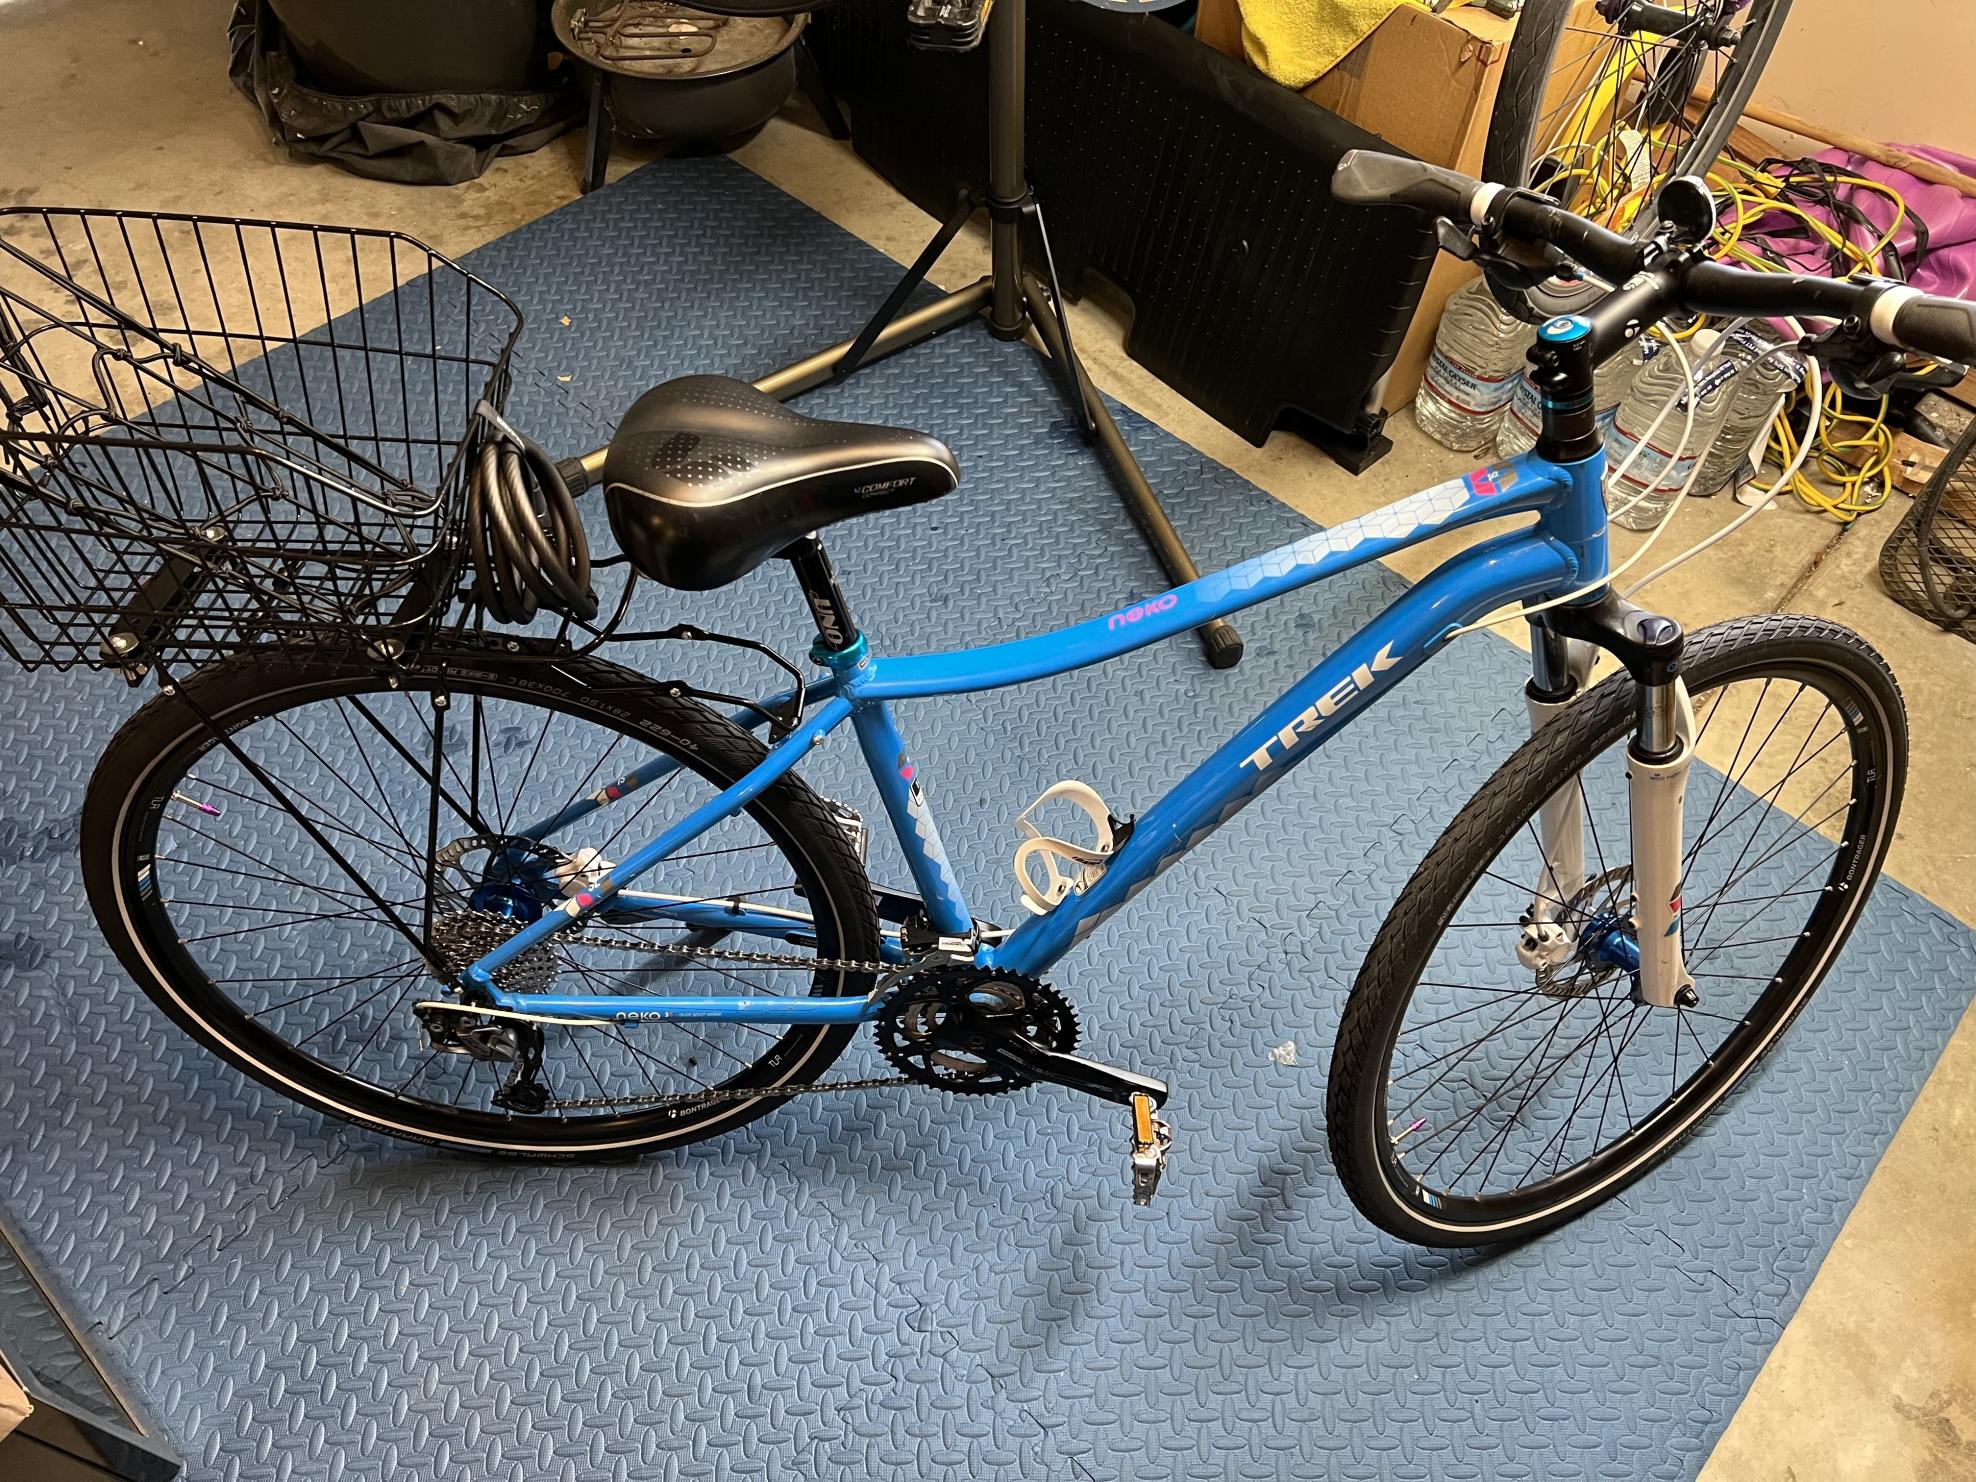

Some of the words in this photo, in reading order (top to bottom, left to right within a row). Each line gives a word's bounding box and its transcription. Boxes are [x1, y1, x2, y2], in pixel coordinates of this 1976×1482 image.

[1448, 369, 1478, 391] GEYSER
[861, 476, 917, 494] COMFORT
[813, 599, 844, 645] UNO
[1108, 594, 1178, 631] neko
[1239, 640, 1403, 771] TREK
[639, 719, 699, 751] 40-622
[1847, 834, 1867, 881] BONTRAGER
[616, 1011, 660, 1020] neko
[768, 1054, 783, 1068] TLR
